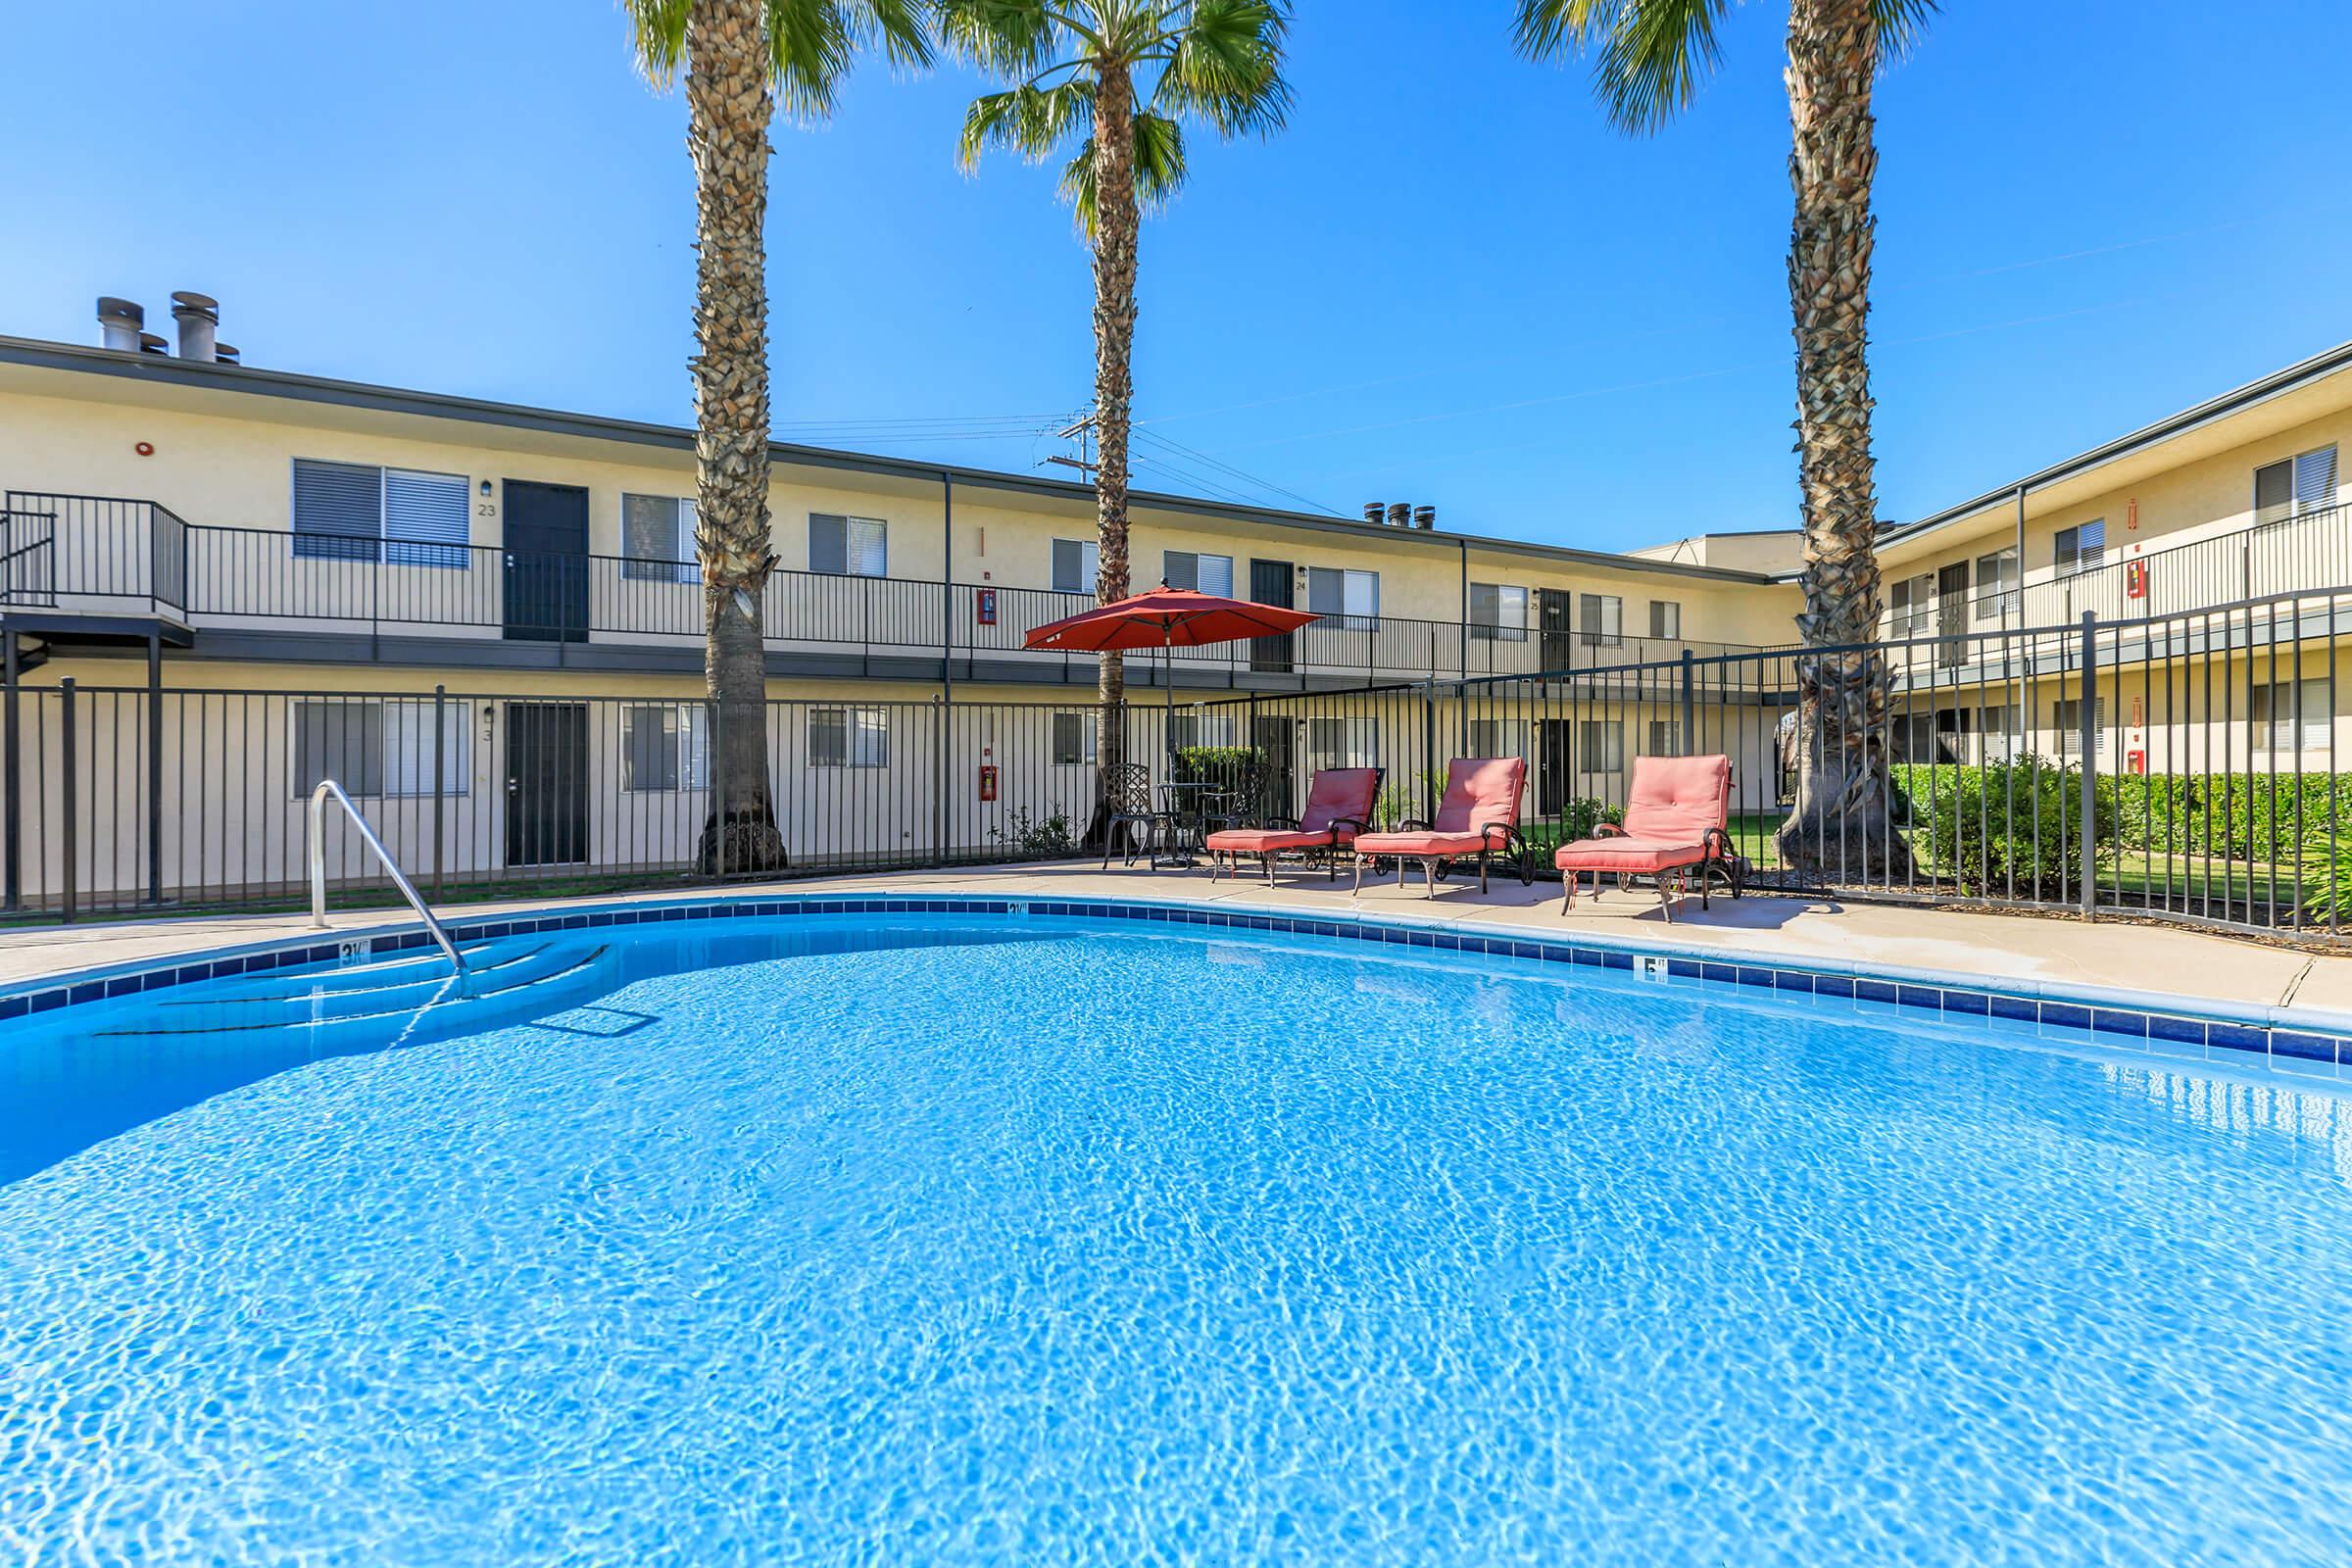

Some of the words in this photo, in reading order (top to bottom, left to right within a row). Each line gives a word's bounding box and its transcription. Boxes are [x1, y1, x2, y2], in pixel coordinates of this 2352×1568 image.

[477, 504, 496, 516] 23
[1296, 582, 1305, 591] 24
[483, 730, 493, 742] 3
[1645, 957, 1656, 972] 5
